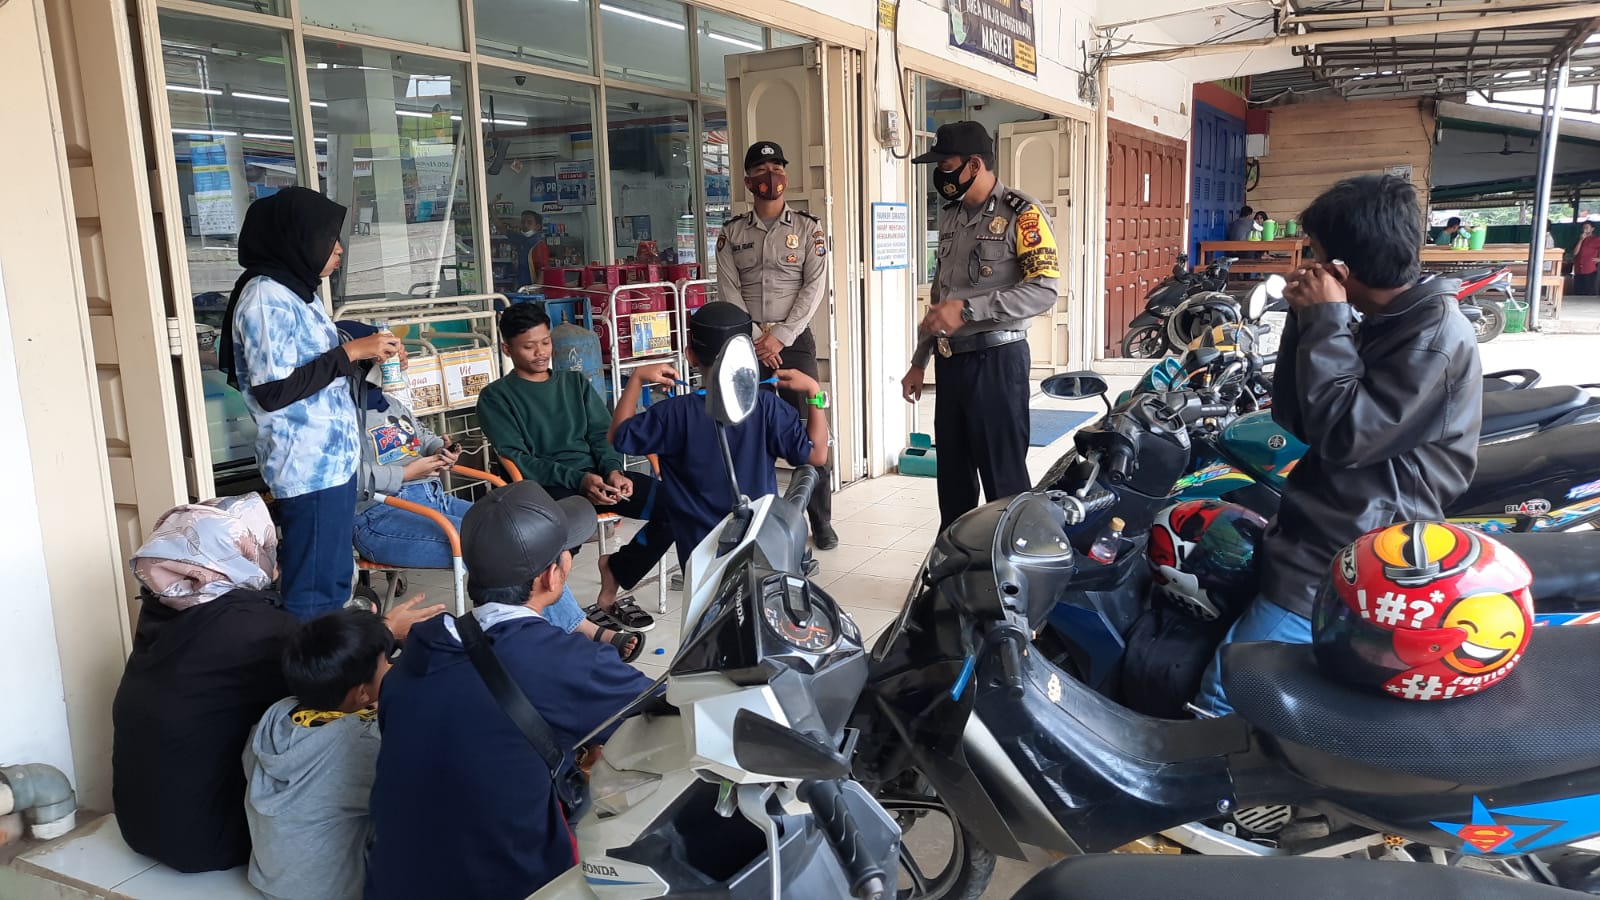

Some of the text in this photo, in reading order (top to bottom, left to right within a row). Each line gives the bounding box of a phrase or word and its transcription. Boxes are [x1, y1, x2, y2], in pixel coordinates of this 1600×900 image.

[981, 23, 1013, 60] MASKER
[459, 364, 472, 376] Vit
[1506, 502, 1543, 513] BLACK
[582, 862, 619, 877] HONDA
